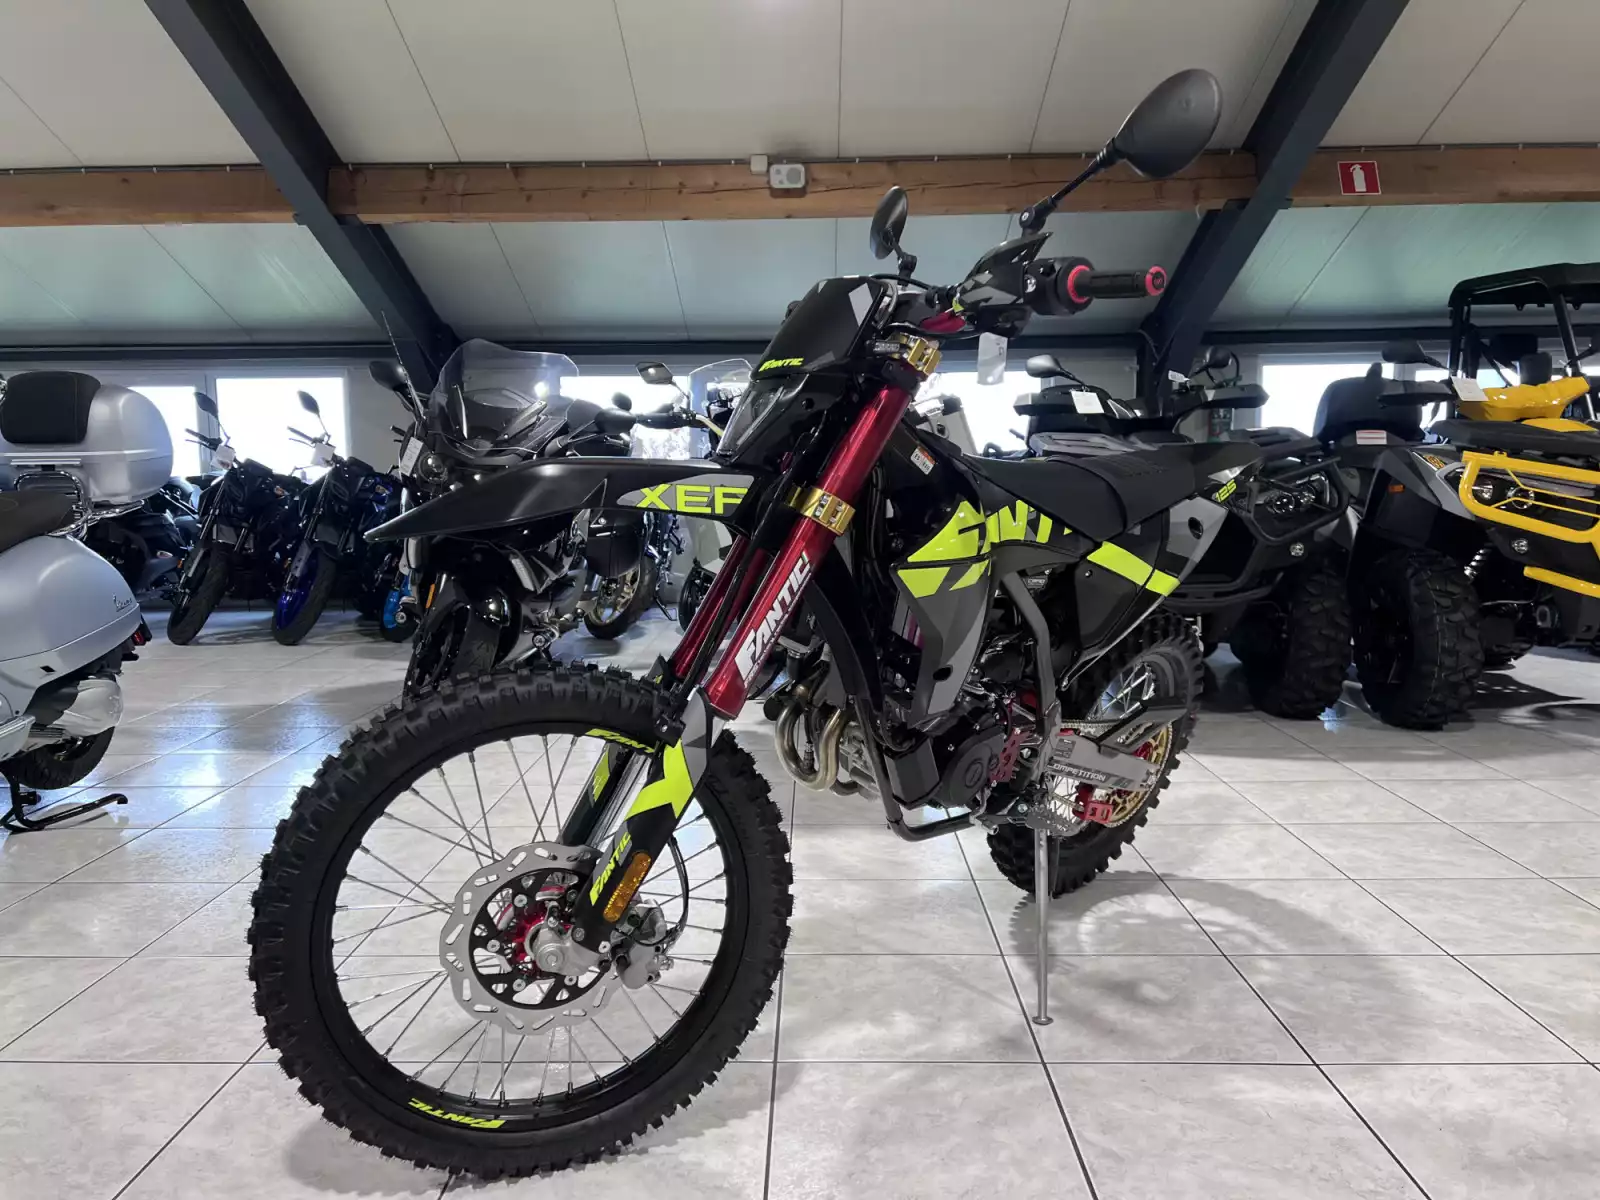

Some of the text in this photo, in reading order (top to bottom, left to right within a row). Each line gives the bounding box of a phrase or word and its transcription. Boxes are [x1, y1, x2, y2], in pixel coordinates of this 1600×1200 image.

[758, 358, 804, 372] FANTIC
[636, 483, 749, 515] XEF
[1215, 479, 1237, 503] 125
[734, 551, 811, 681] FANTIC
[589, 831, 631, 906] FANTIC
[408, 1098, 506, 1129] FANTIC
